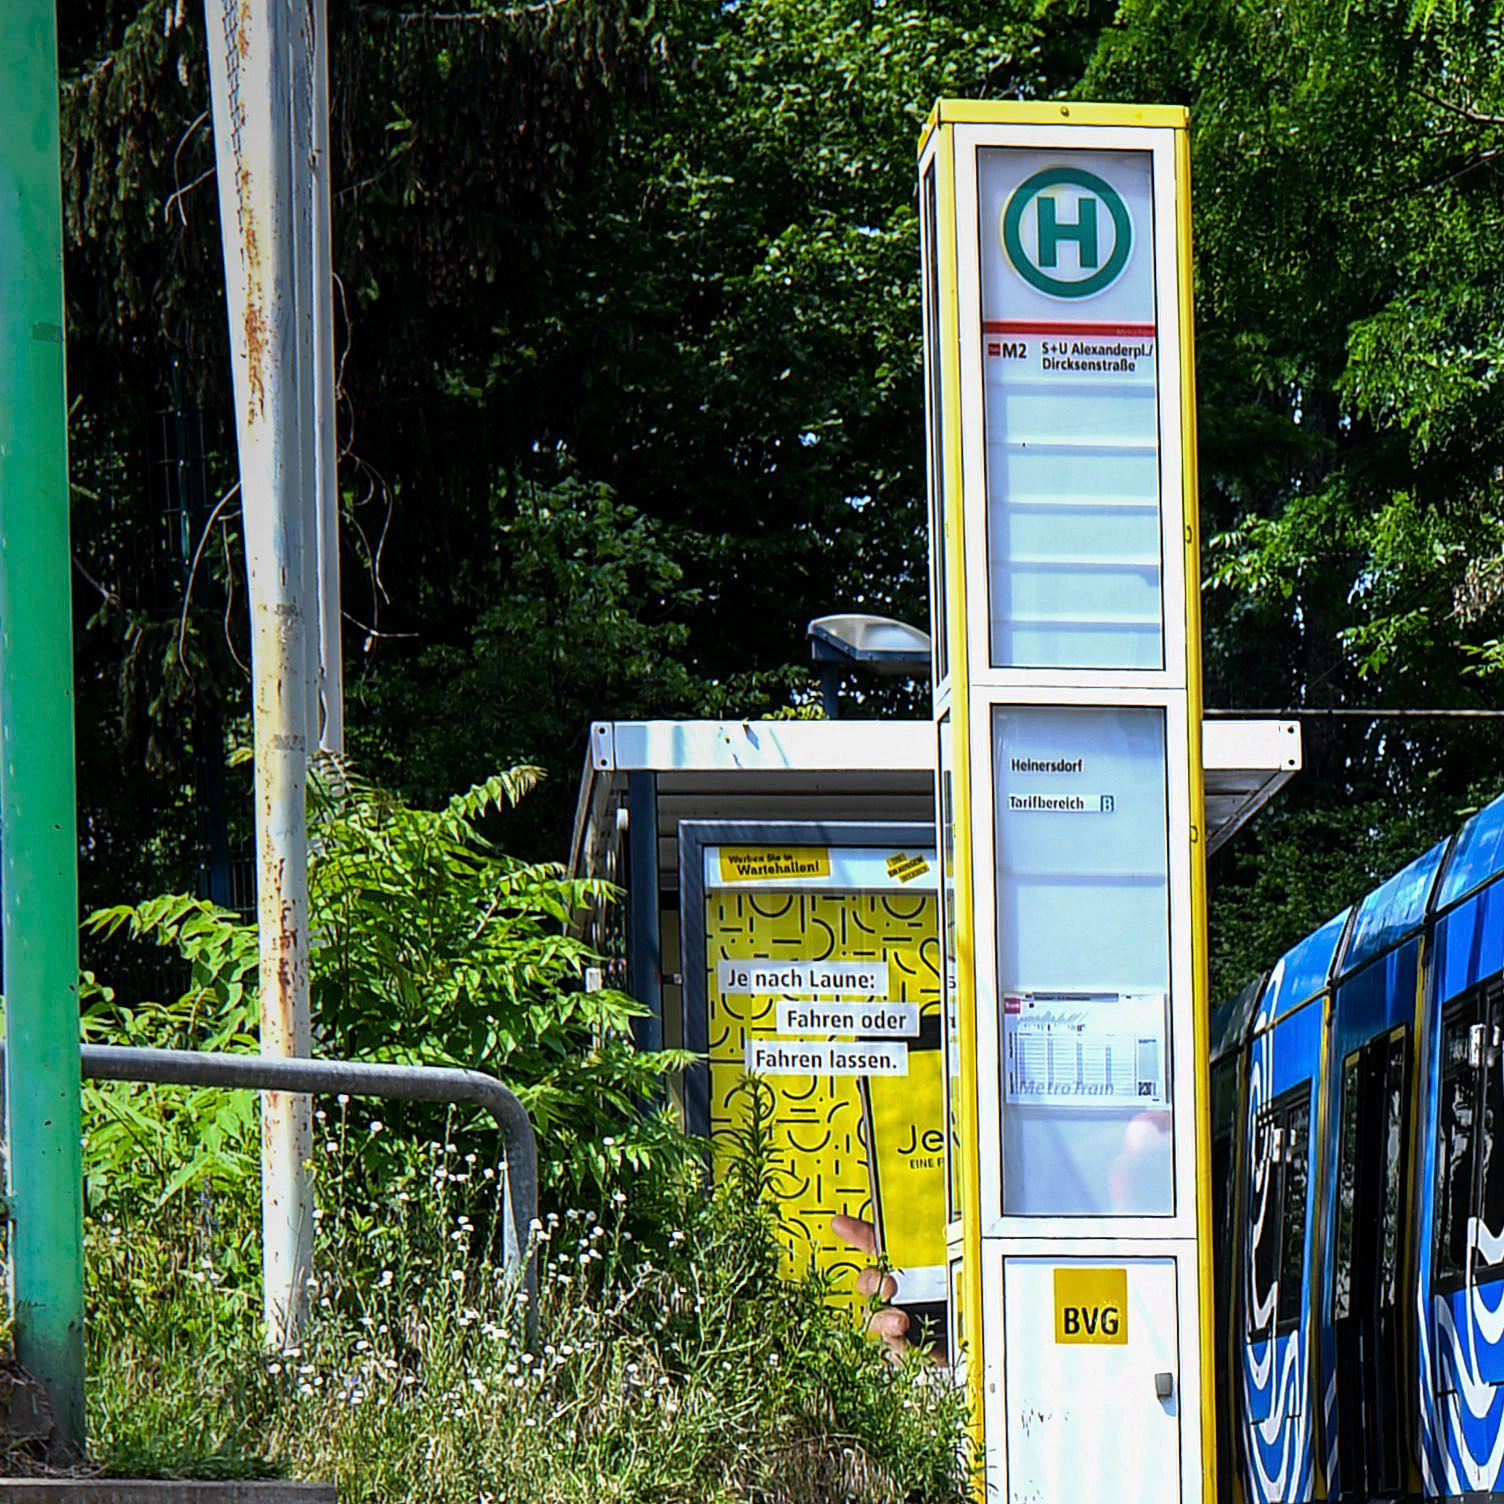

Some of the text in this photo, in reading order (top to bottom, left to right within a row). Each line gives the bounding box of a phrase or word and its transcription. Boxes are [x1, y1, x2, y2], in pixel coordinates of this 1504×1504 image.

[1037, 196, 1098, 268] H
[1002, 343, 1027, 358] M2
[1042, 341, 1068, 355] S+U
[1071, 342, 1154, 359] Alexanderpl./
[1042, 357, 1136, 372] Dircksenstraße
[1011, 758, 1083, 773] Heinersdorf
[1010, 795, 1085, 810] Tarifbereich
[737, 860, 820, 876] Wartehallen!
[728, 968, 875, 989] Je nach Laune:
[787, 1009, 907, 1030] Fahren oder
[756, 1049, 898, 1070] Fahren lassen.
[1064, 1307, 1119, 1335] BVG
